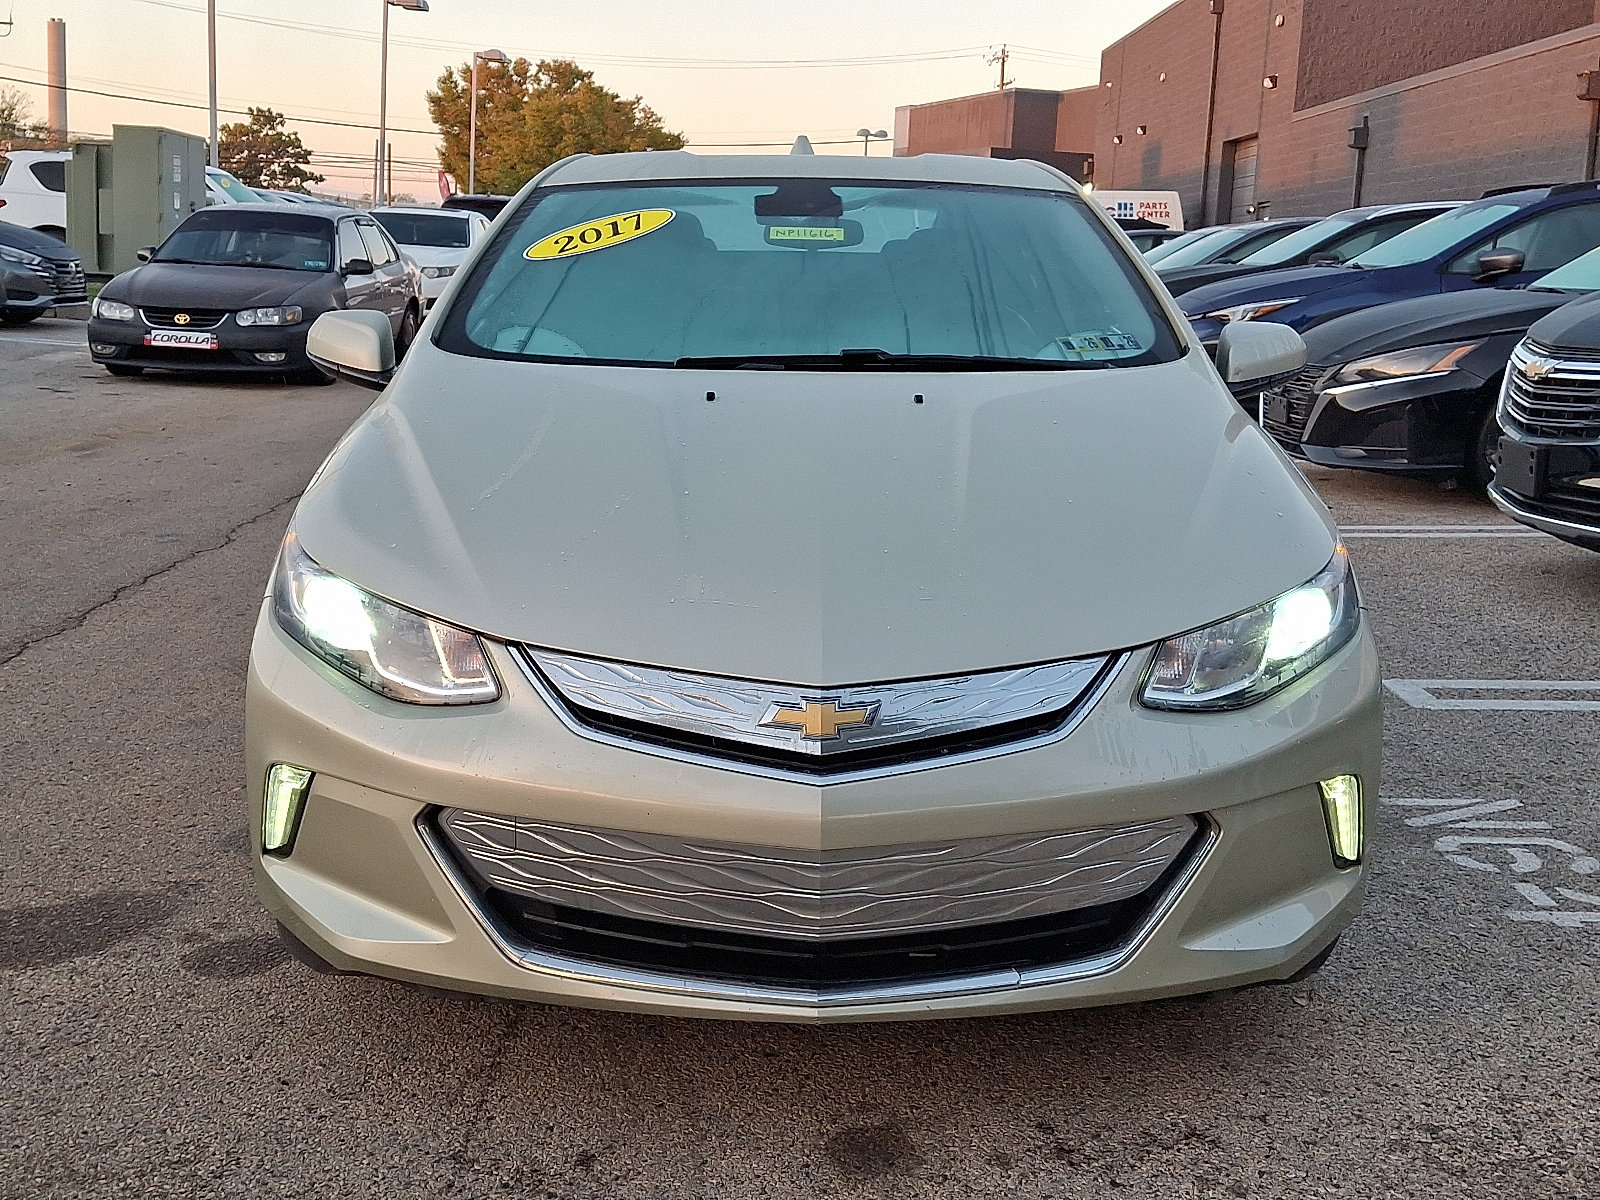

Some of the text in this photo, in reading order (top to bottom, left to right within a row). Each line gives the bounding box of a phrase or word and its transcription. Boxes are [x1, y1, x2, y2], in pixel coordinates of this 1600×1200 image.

[1139, 202, 1168, 210] PARTS
[1136, 210, 1171, 219] CENTER
[554, 213, 642, 254] 2017
[153, 333, 210, 345] COROLLA
